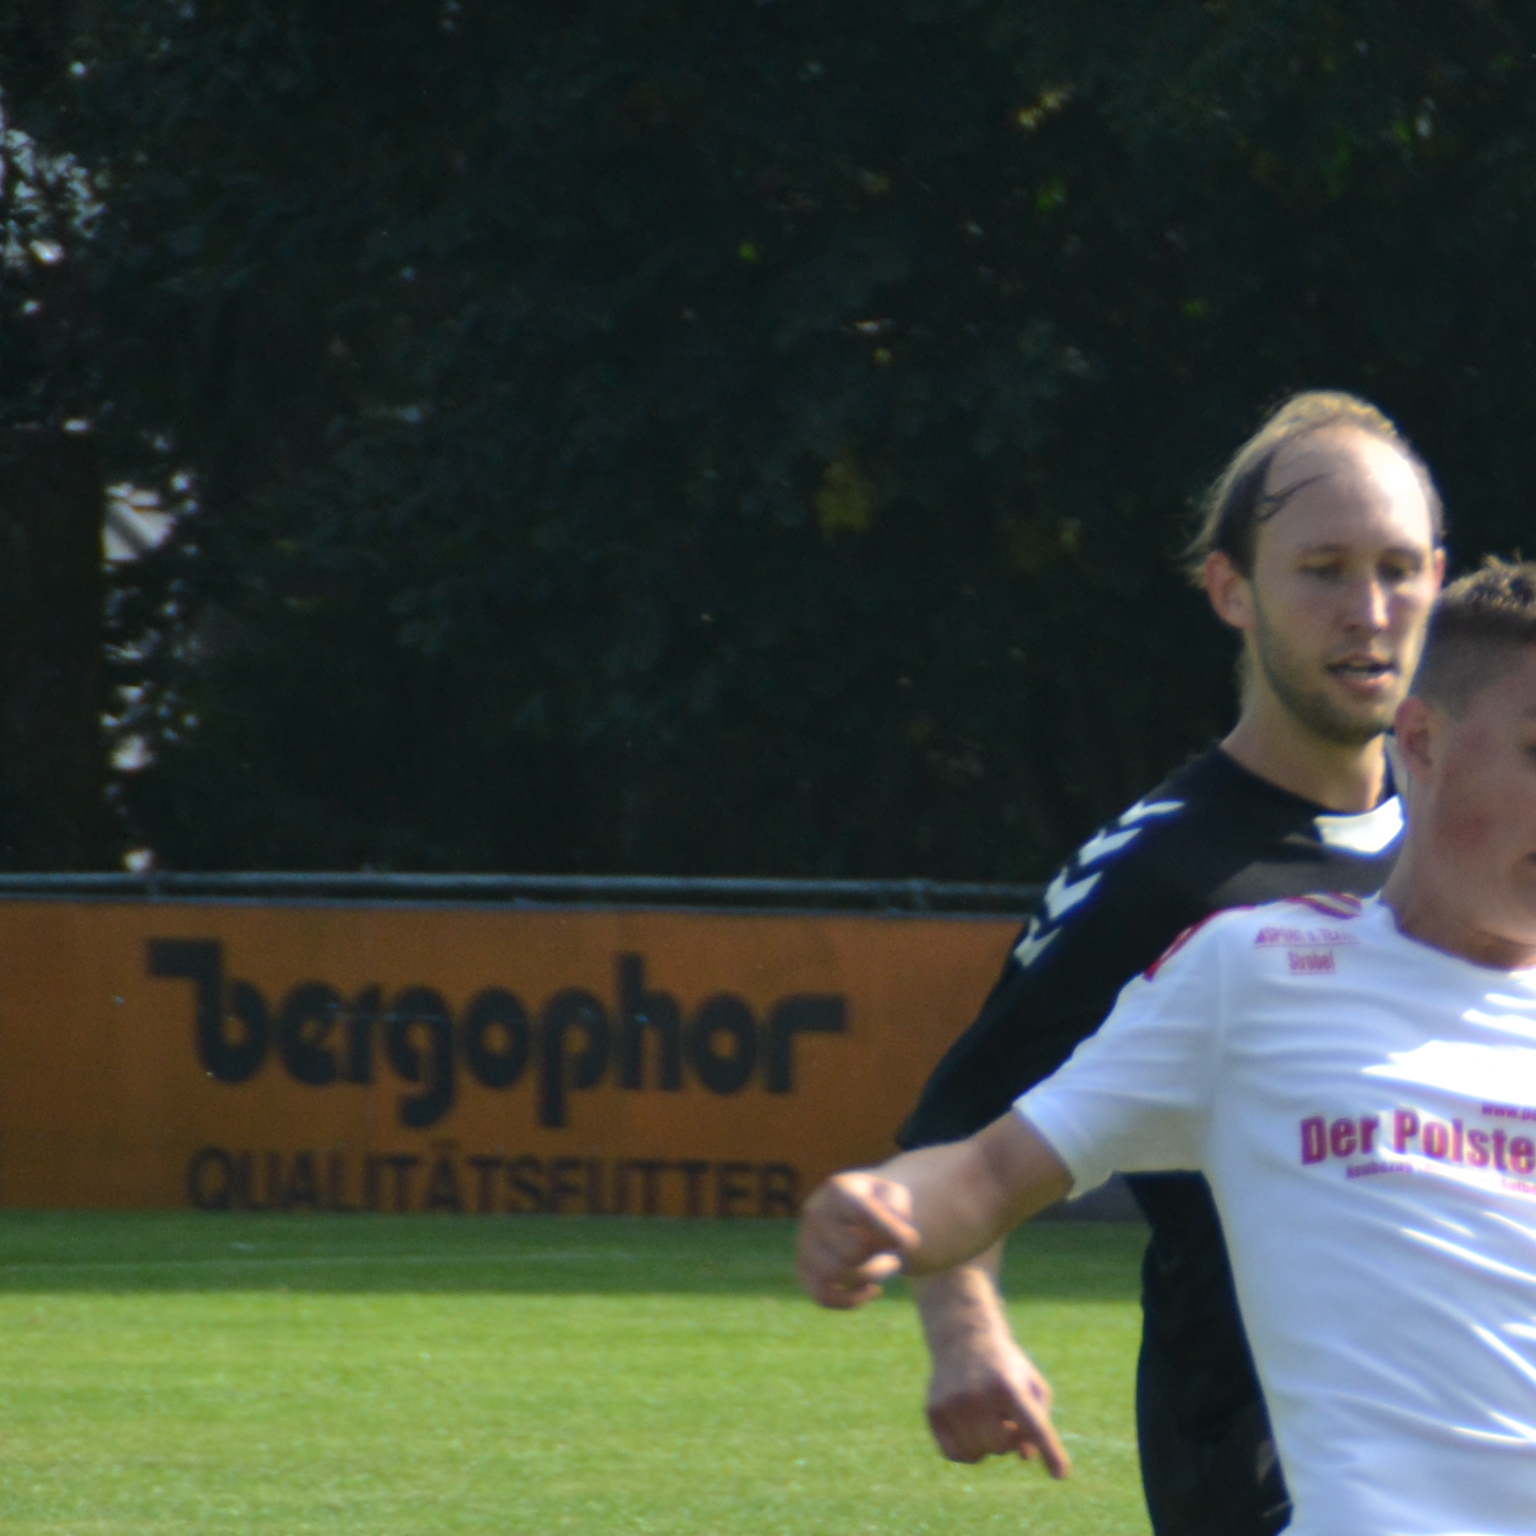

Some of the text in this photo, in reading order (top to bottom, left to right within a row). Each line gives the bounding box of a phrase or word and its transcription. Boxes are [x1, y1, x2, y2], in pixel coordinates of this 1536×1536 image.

[150, 938, 848, 1129] bergophor
[185, 1139, 799, 1217] QUALITÄTSFUTTER
[1300, 1116, 1380, 1165] Der
